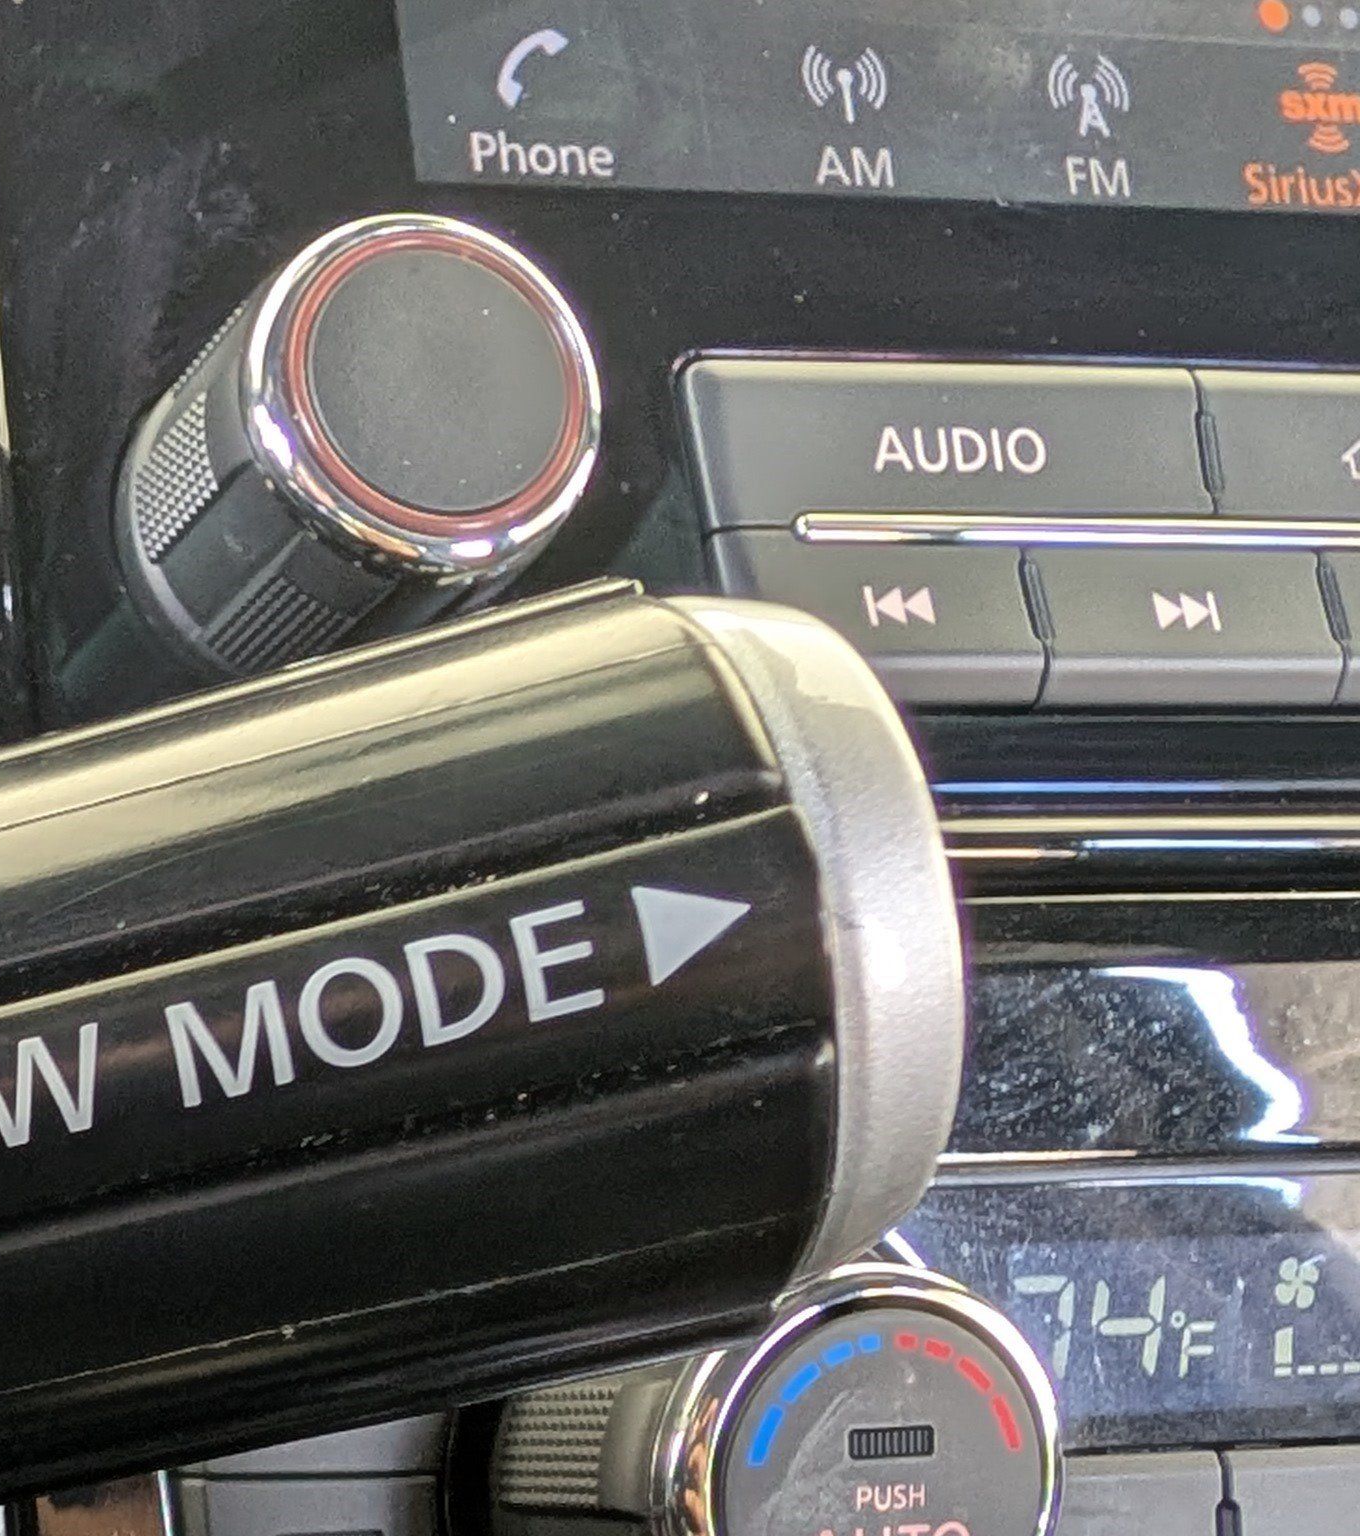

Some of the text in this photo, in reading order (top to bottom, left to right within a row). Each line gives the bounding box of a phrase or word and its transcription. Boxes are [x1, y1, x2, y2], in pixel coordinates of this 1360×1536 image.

[471, 131, 615, 178] Phone
[815, 146, 895, 188] AM
[1065, 155, 1131, 197] FM
[875, 426, 1047, 474] AUDIO
[164, 899, 604, 1108] MODE
[855, 1484, 926, 1511] PUSH
